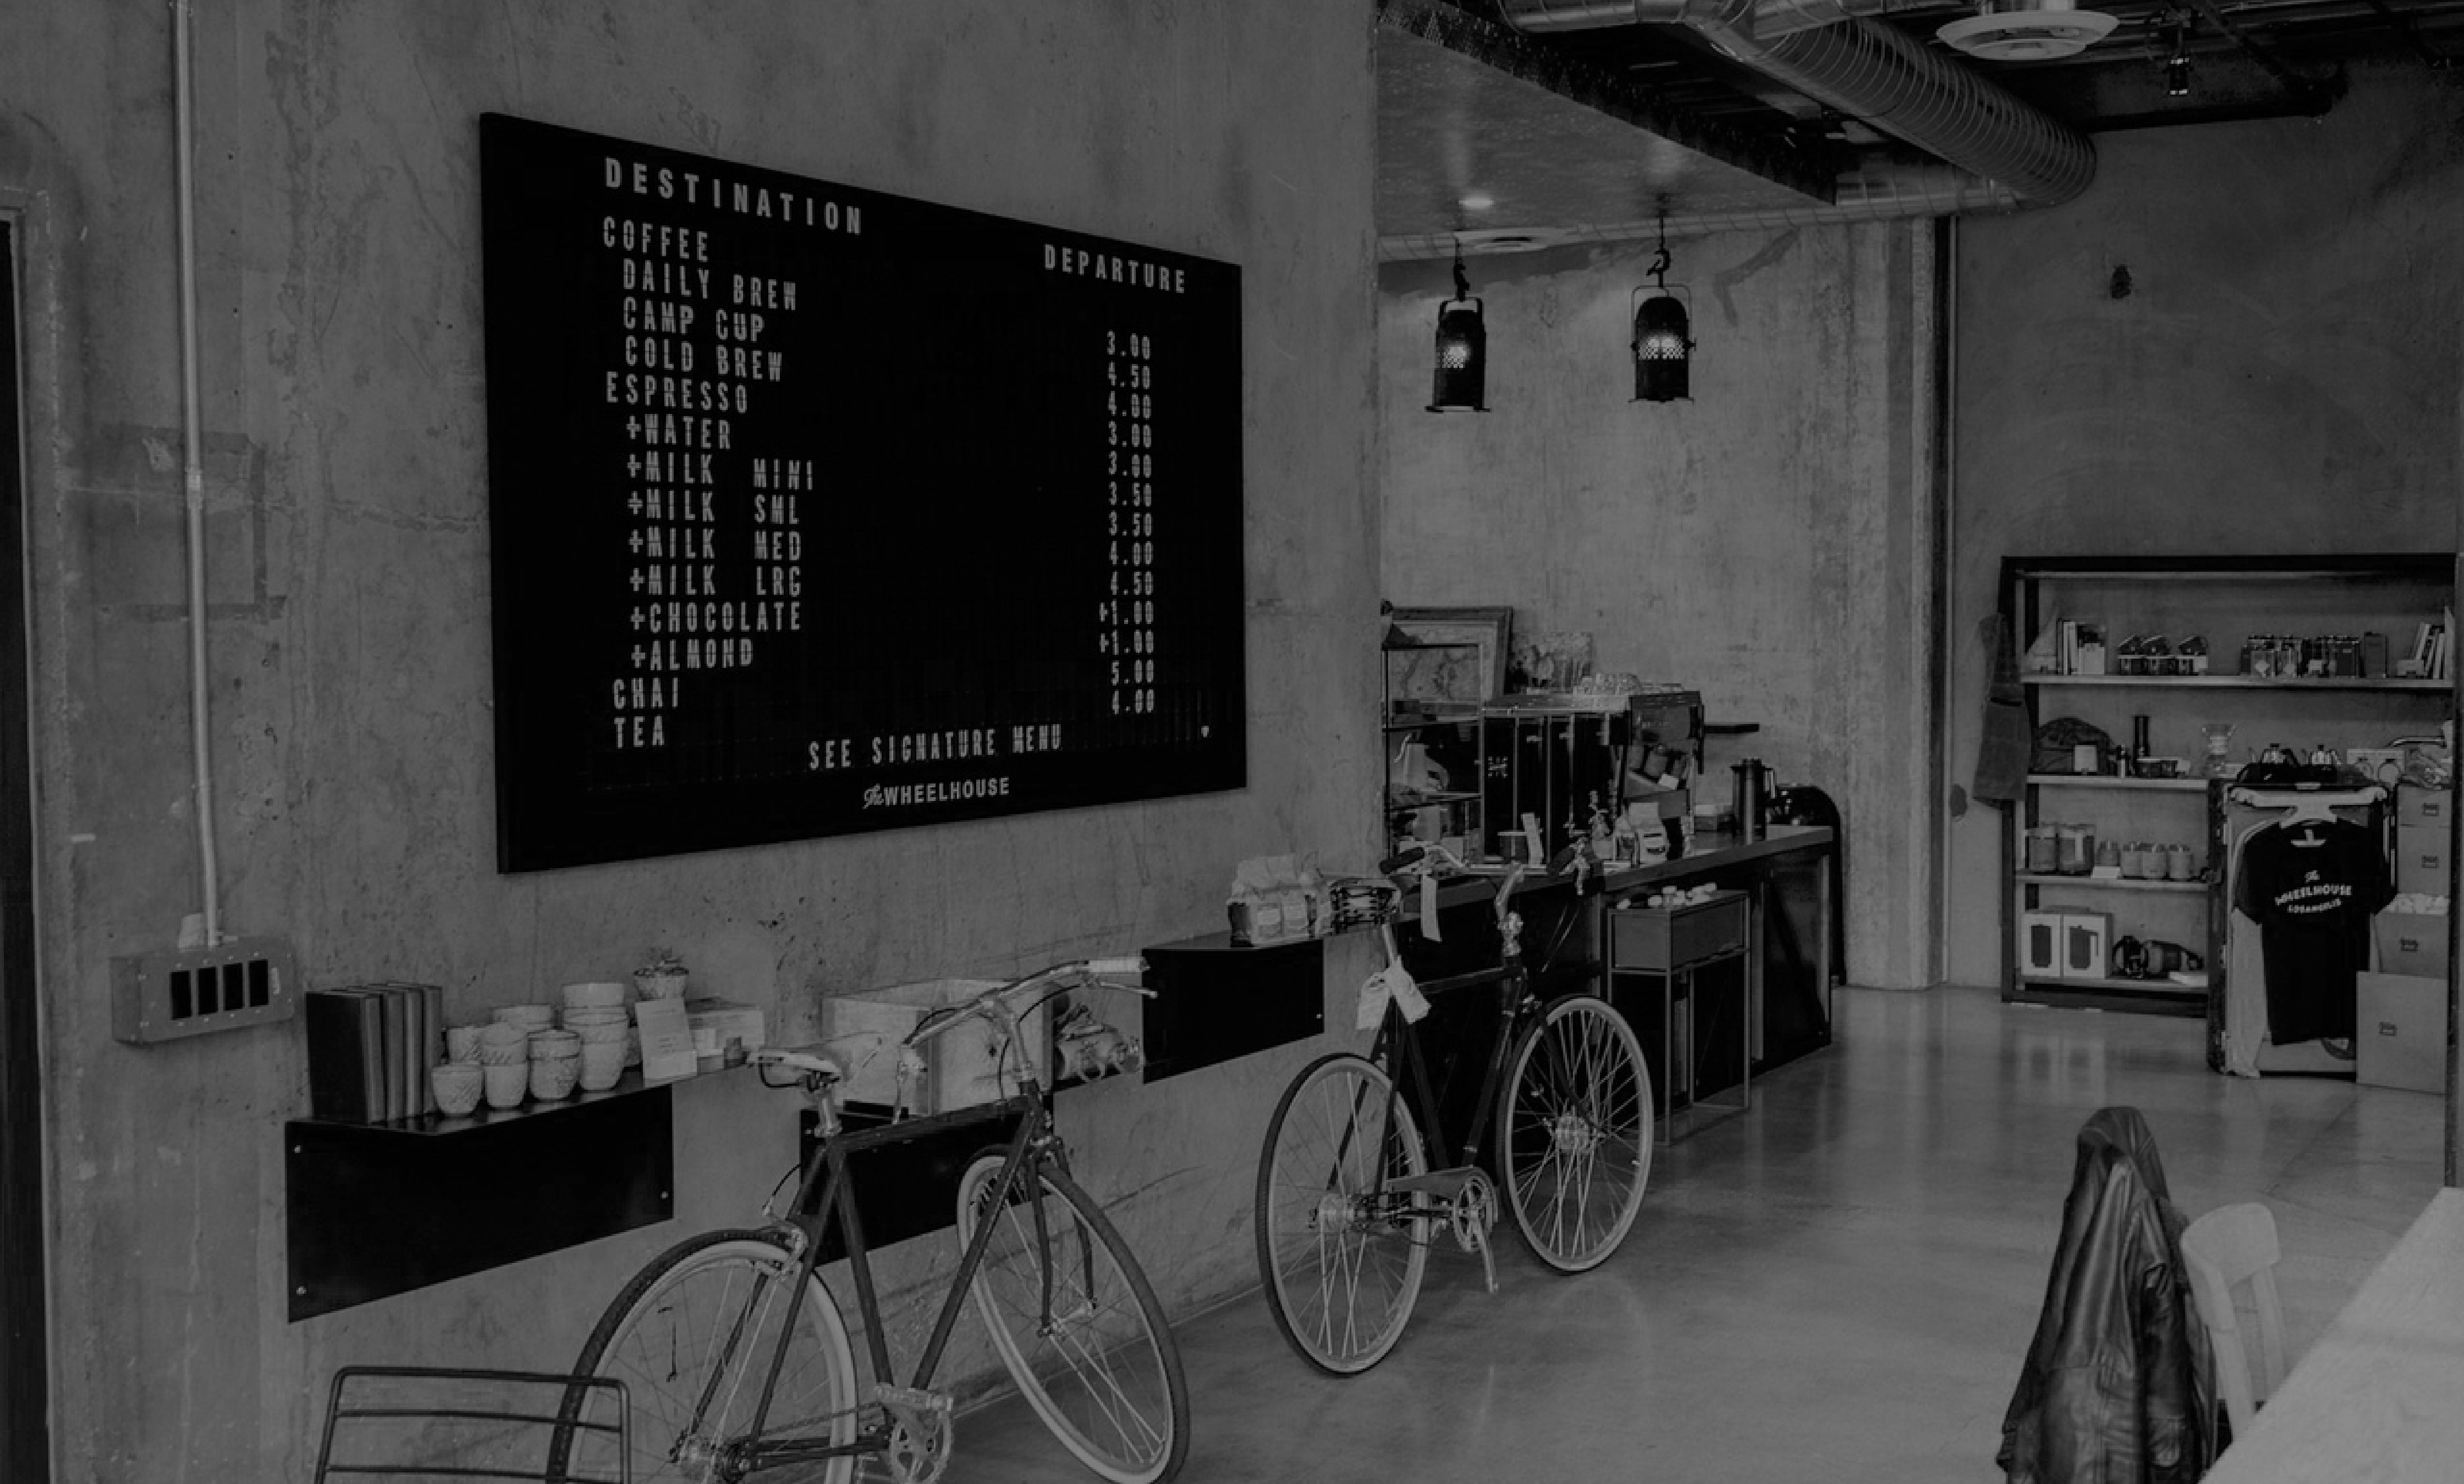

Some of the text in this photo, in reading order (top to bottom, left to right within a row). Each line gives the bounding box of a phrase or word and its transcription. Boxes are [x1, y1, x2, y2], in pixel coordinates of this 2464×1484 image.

[603, 157, 1185, 294] DESTINATION DEPARTURE
[603, 215, 708, 263] COFFEE
[623, 257, 1151, 361] DAILY BREW 3.00
[623, 296, 1151, 390] CAMP CUP 4.50
[625, 334, 1152, 421] COLD BREW 4.00
[606, 370, 1152, 448] ESPRESSO 3.00
[753, 457, 813, 491] MINI
[1108, 480, 1152, 508] 3.50
[1108, 450, 1152, 479] 3.00
[753, 493, 800, 525] SML
[1108, 509, 1152, 538] 3.50
[753, 529, 802, 561] MED
[1108, 540, 1154, 567] 4.00
[756, 565, 802, 598] LRG
[1110, 570, 1154, 596] 4.50
[613, 658, 1154, 710] CHAI 5.00
[613, 688, 1155, 750] TEA 4.00
[808, 723, 1062, 771] SEE SIGNATURE MENU
[883, 777, 1010, 806] WHEELHOUSE
